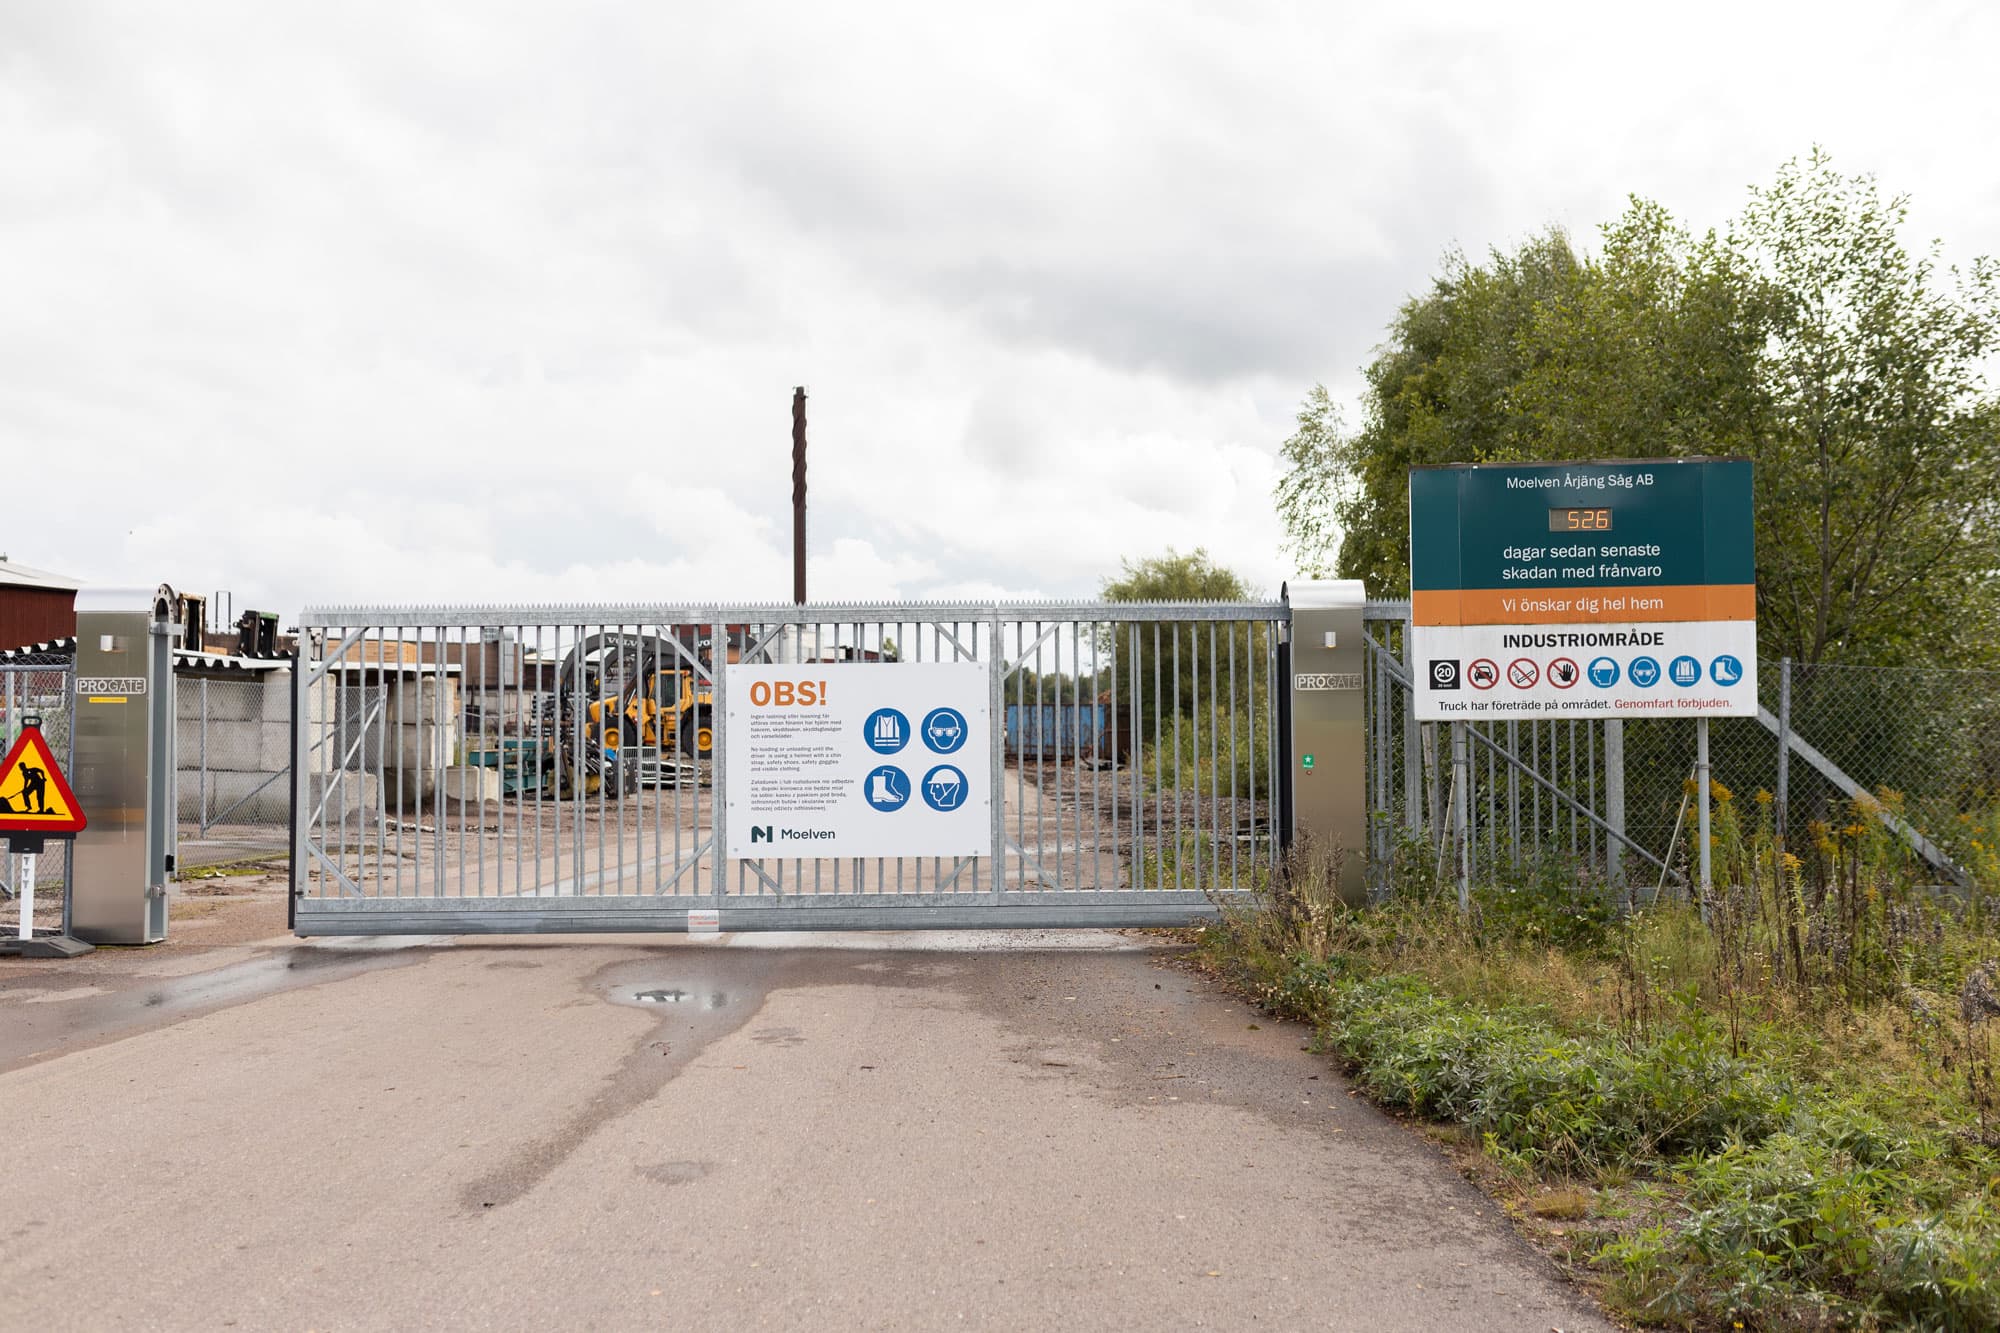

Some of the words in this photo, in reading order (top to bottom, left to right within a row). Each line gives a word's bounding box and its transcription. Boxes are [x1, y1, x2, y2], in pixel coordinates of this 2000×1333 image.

[1506, 477, 1560, 489] Moelven
[1564, 473, 1605, 489] Årjäng
[1608, 474, 1633, 489] Såg
[1636, 474, 1654, 486] AB
[1568, 510, 1609, 529] 526
[1503, 546, 1546, 562] dagar
[1550, 545, 1596, 558] sedan
[1600, 544, 1661, 557] senaste
[1502, 566, 1557, 580] skadan
[1562, 565, 1595, 578] med
[1599, 563, 1662, 577] frånvaro
[1502, 599, 1516, 613] Vi
[1520, 598, 1572, 612] önskar
[1575, 597, 1600, 613] dig
[1603, 597, 1626, 610] hel
[1630, 597, 1664, 609] hem
[1503, 628, 1664, 648] INDUSTRIOMRÅDE
[1438, 667, 1451, 678] 20
[79, 680, 143, 693] PROGATE
[1298, 676, 1361, 689] PROGATE
[750, 680, 827, 707] OBS!
[1439, 701, 1467, 711] Truck
[1471, 701, 1488, 710] har
[1492, 700, 1541, 711] företräde
[1544, 699, 1558, 712] på
[1562, 699, 1611, 710] området.
[1614, 698, 1674, 709] Genomfart
[1677, 698, 1733, 711] förbjuden.
[781, 828, 836, 840] Moelven
